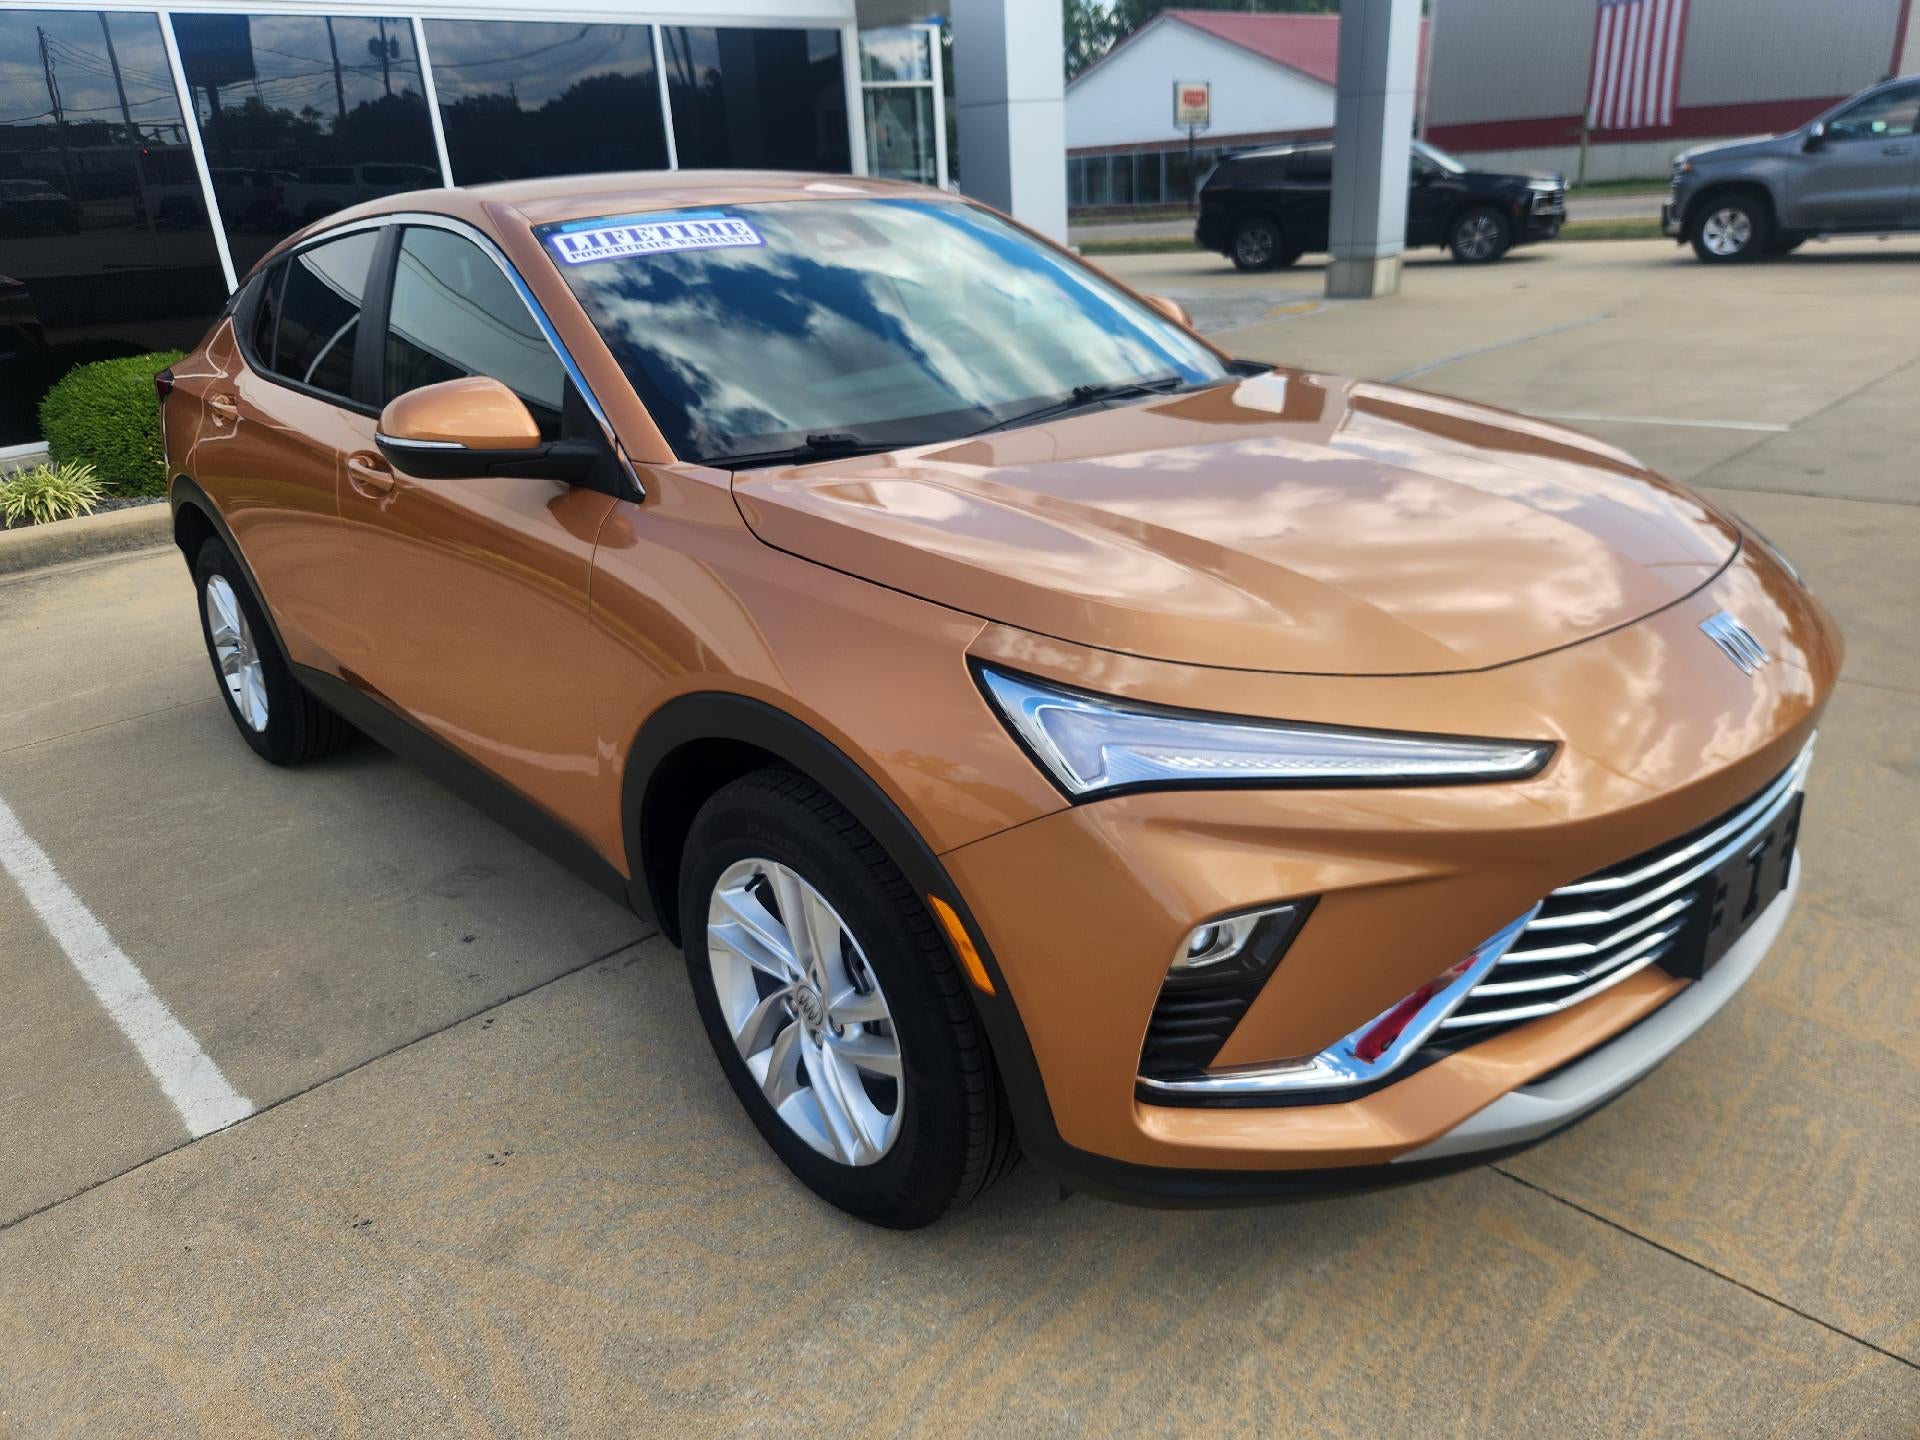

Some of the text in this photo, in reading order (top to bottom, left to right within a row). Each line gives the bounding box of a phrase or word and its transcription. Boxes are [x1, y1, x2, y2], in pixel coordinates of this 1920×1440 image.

[562, 222, 750, 252] LIFETIME
[570, 236, 754, 260] POWERTRAIN WARRANTY
